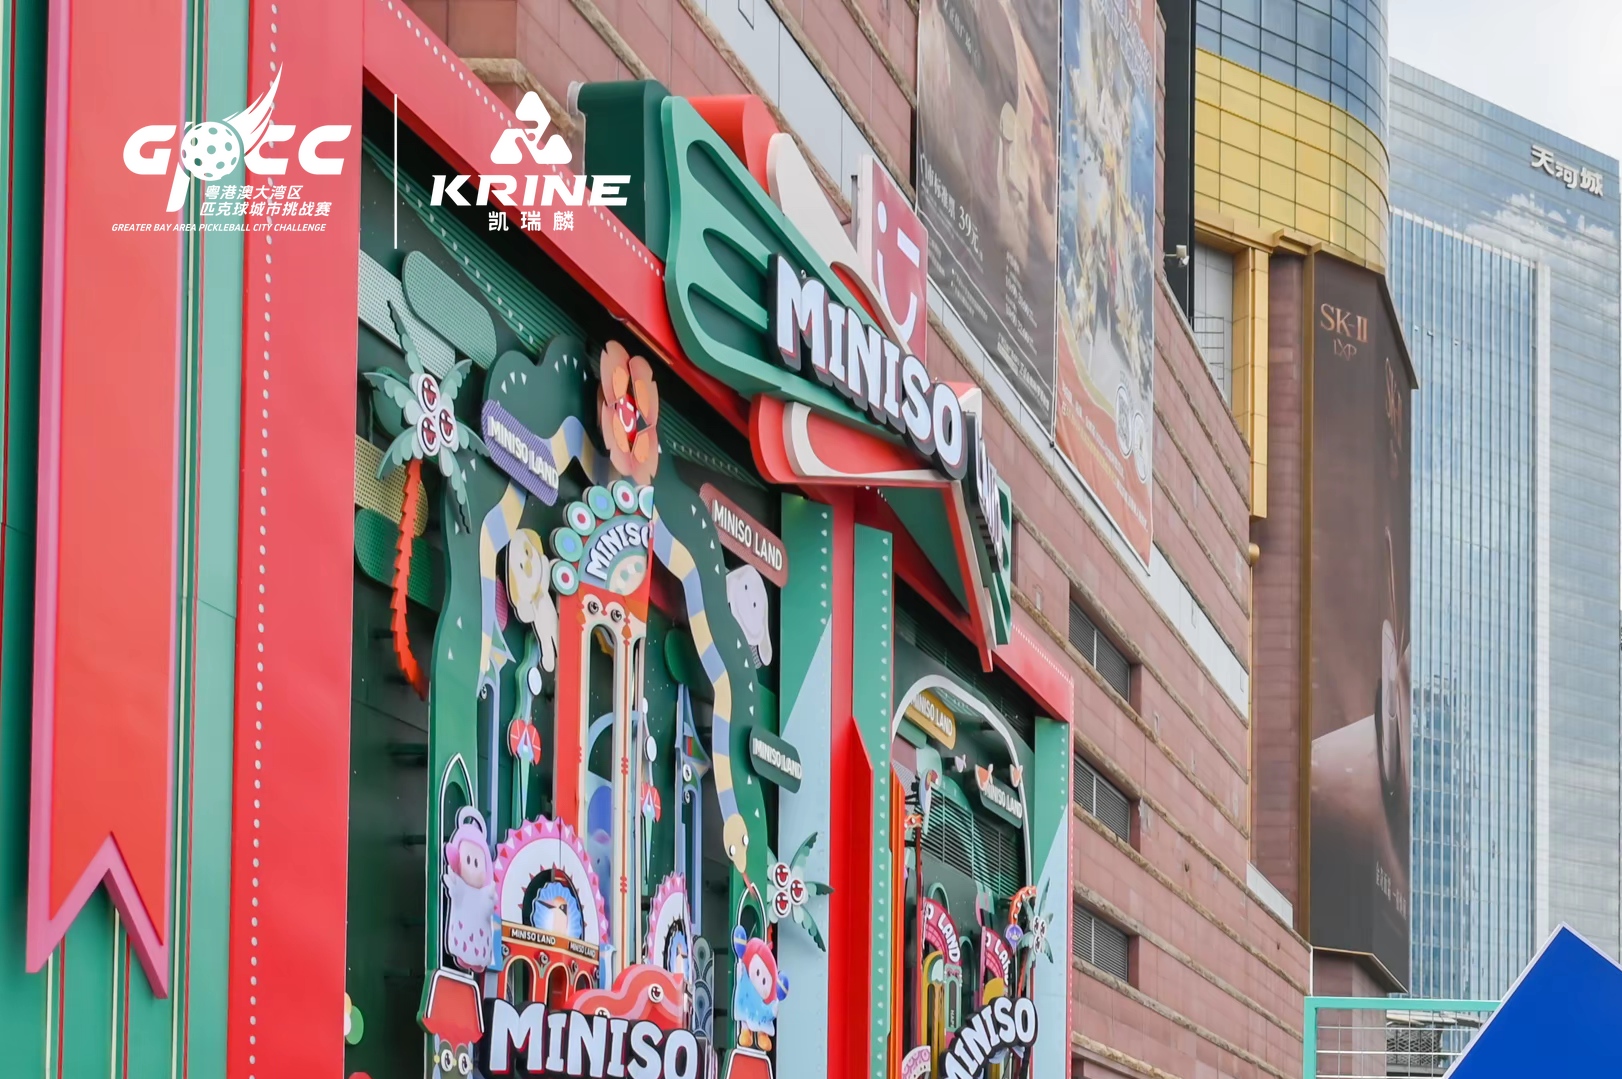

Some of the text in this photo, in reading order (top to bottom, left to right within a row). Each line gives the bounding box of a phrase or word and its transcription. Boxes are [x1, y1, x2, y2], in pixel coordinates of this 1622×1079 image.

[1530, 144, 1604, 197] 天河城
[1320, 303, 1368, 343] SK-II
[776, 254, 965, 468] MINISO
[487, 415, 560, 490] MINISO LAND
[713, 499, 783, 572] MINISO LAND
[753, 737, 802, 780] MINISO LAND
[511, 928, 556, 946] MINISO LAND
[938, 911, 961, 963] LAND
